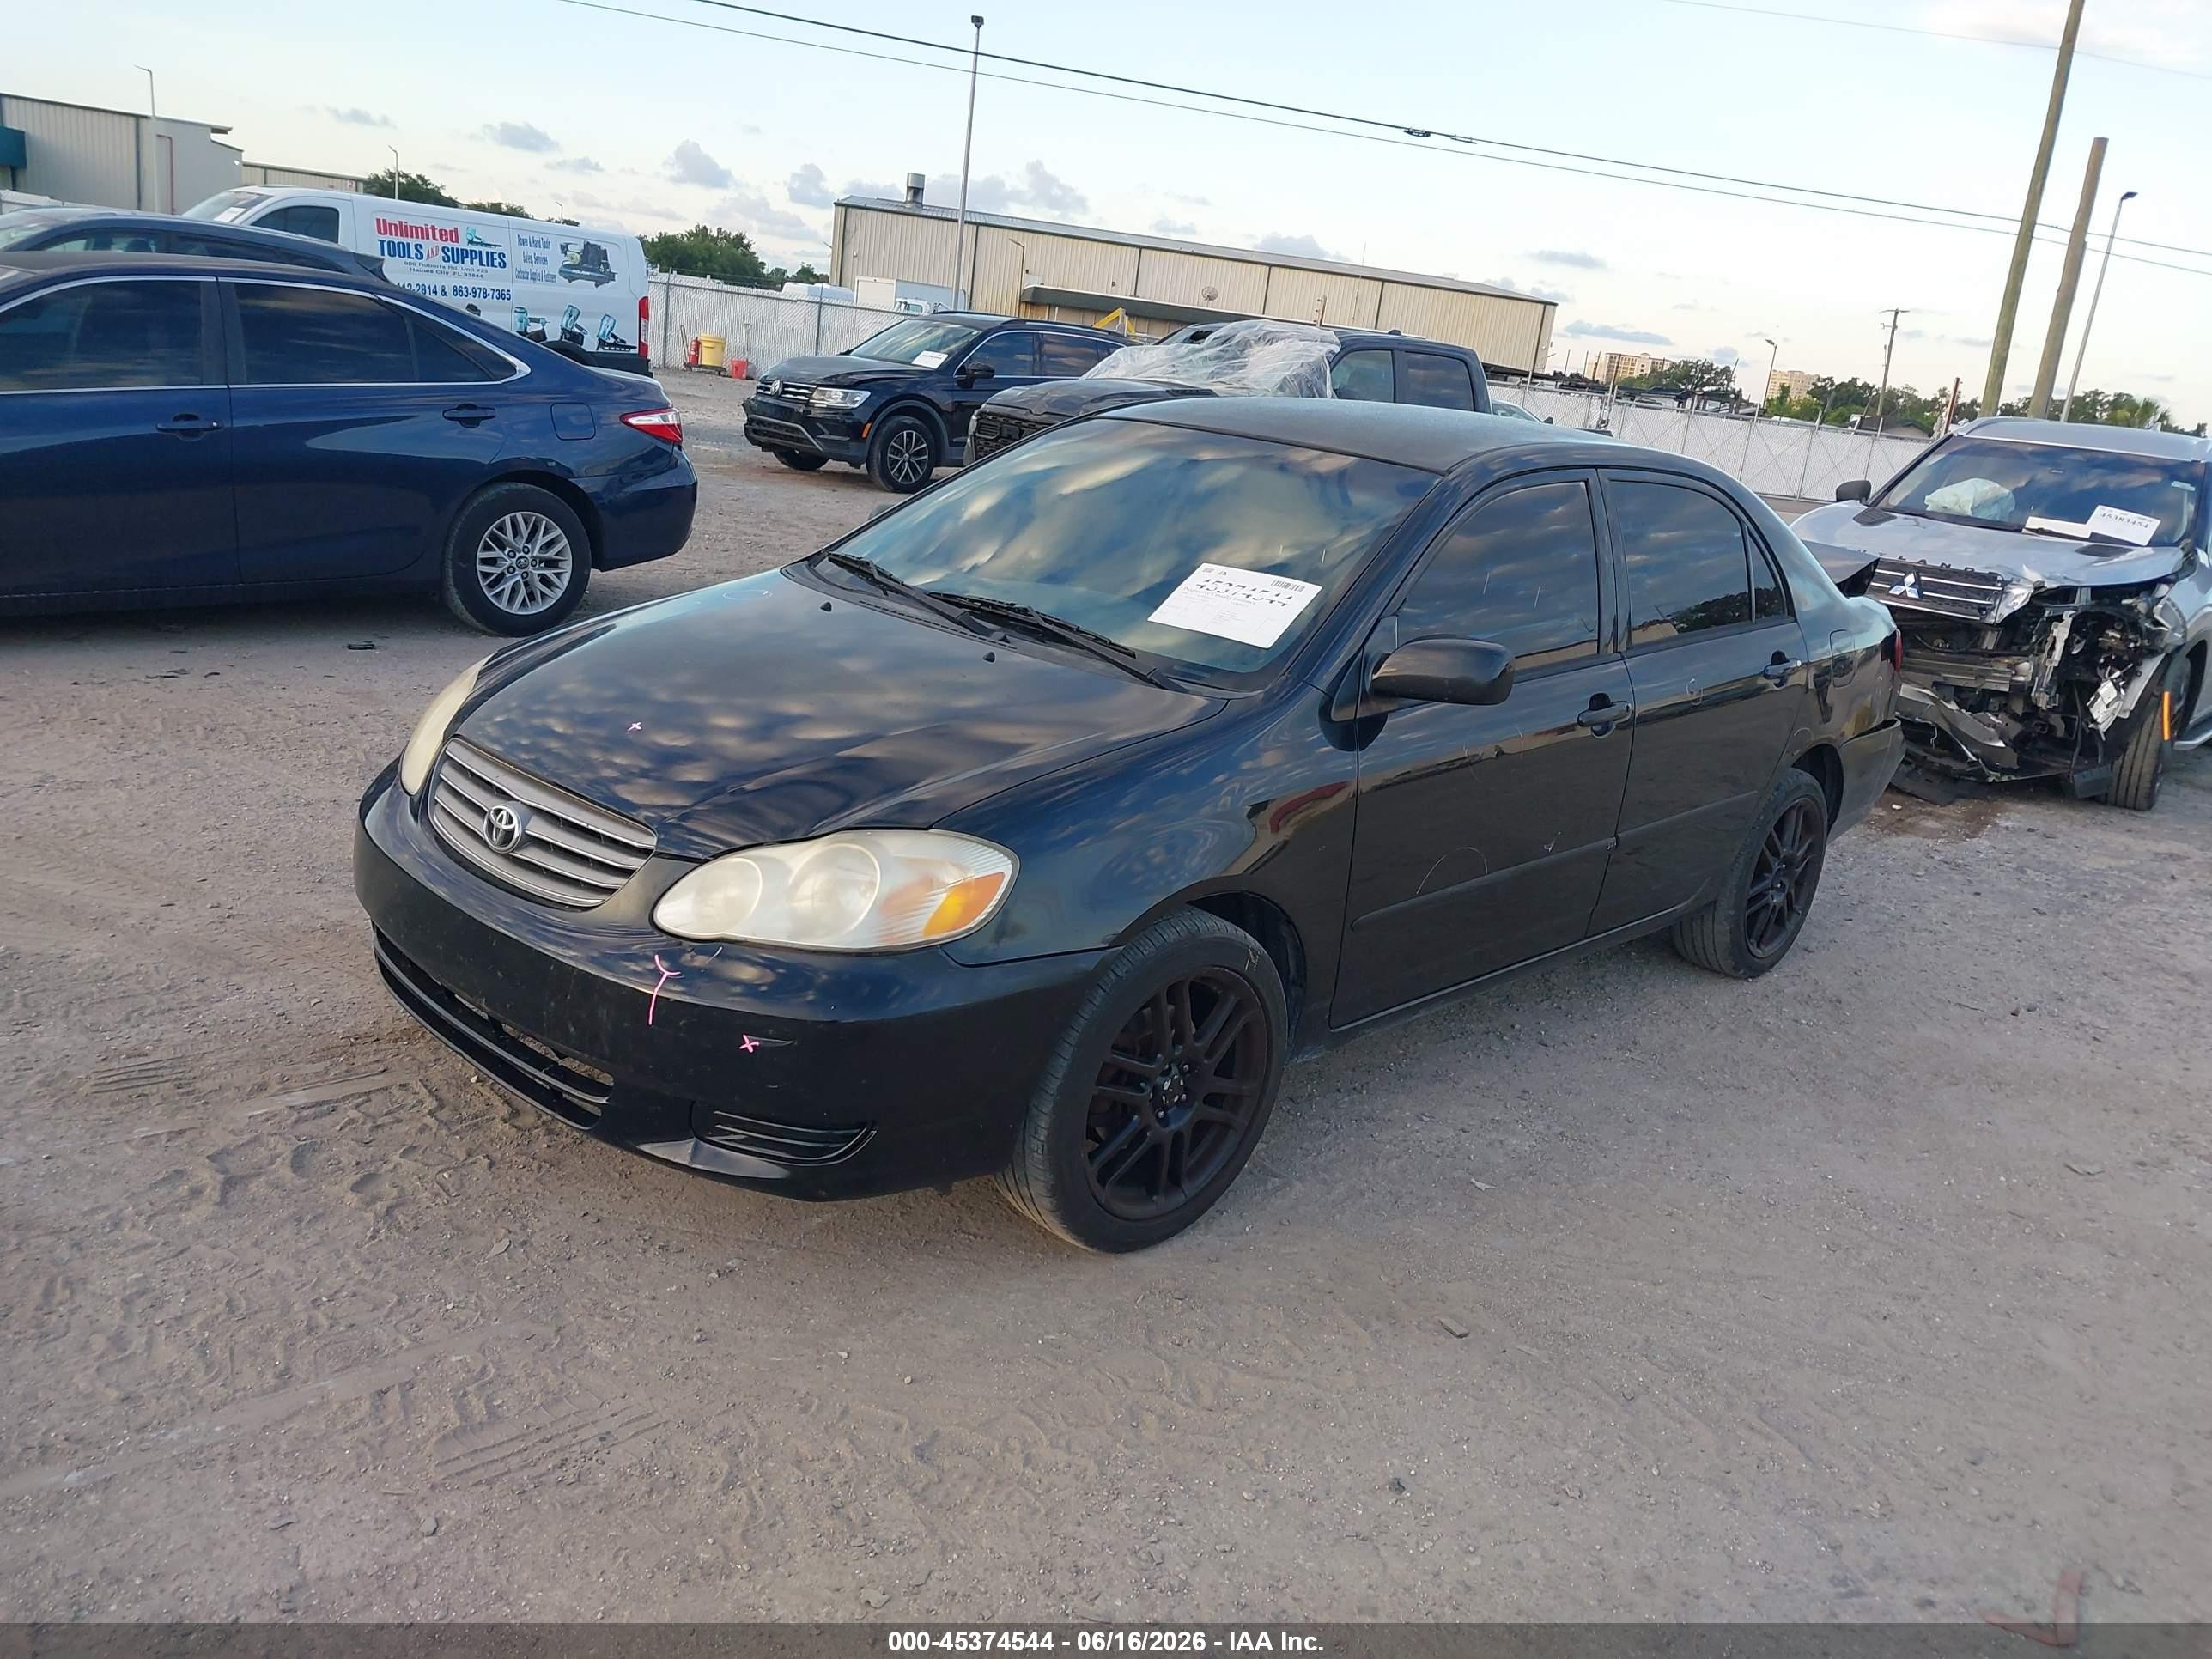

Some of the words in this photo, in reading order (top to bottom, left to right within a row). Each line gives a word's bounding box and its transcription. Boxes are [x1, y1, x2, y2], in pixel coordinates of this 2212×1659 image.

[375, 218, 459, 244] Unlimited
[378, 239, 424, 260] TOOLS
[426, 246, 440, 261] AND
[441, 246, 507, 269] SUPPLIES
[441, 284, 447, 297] &
